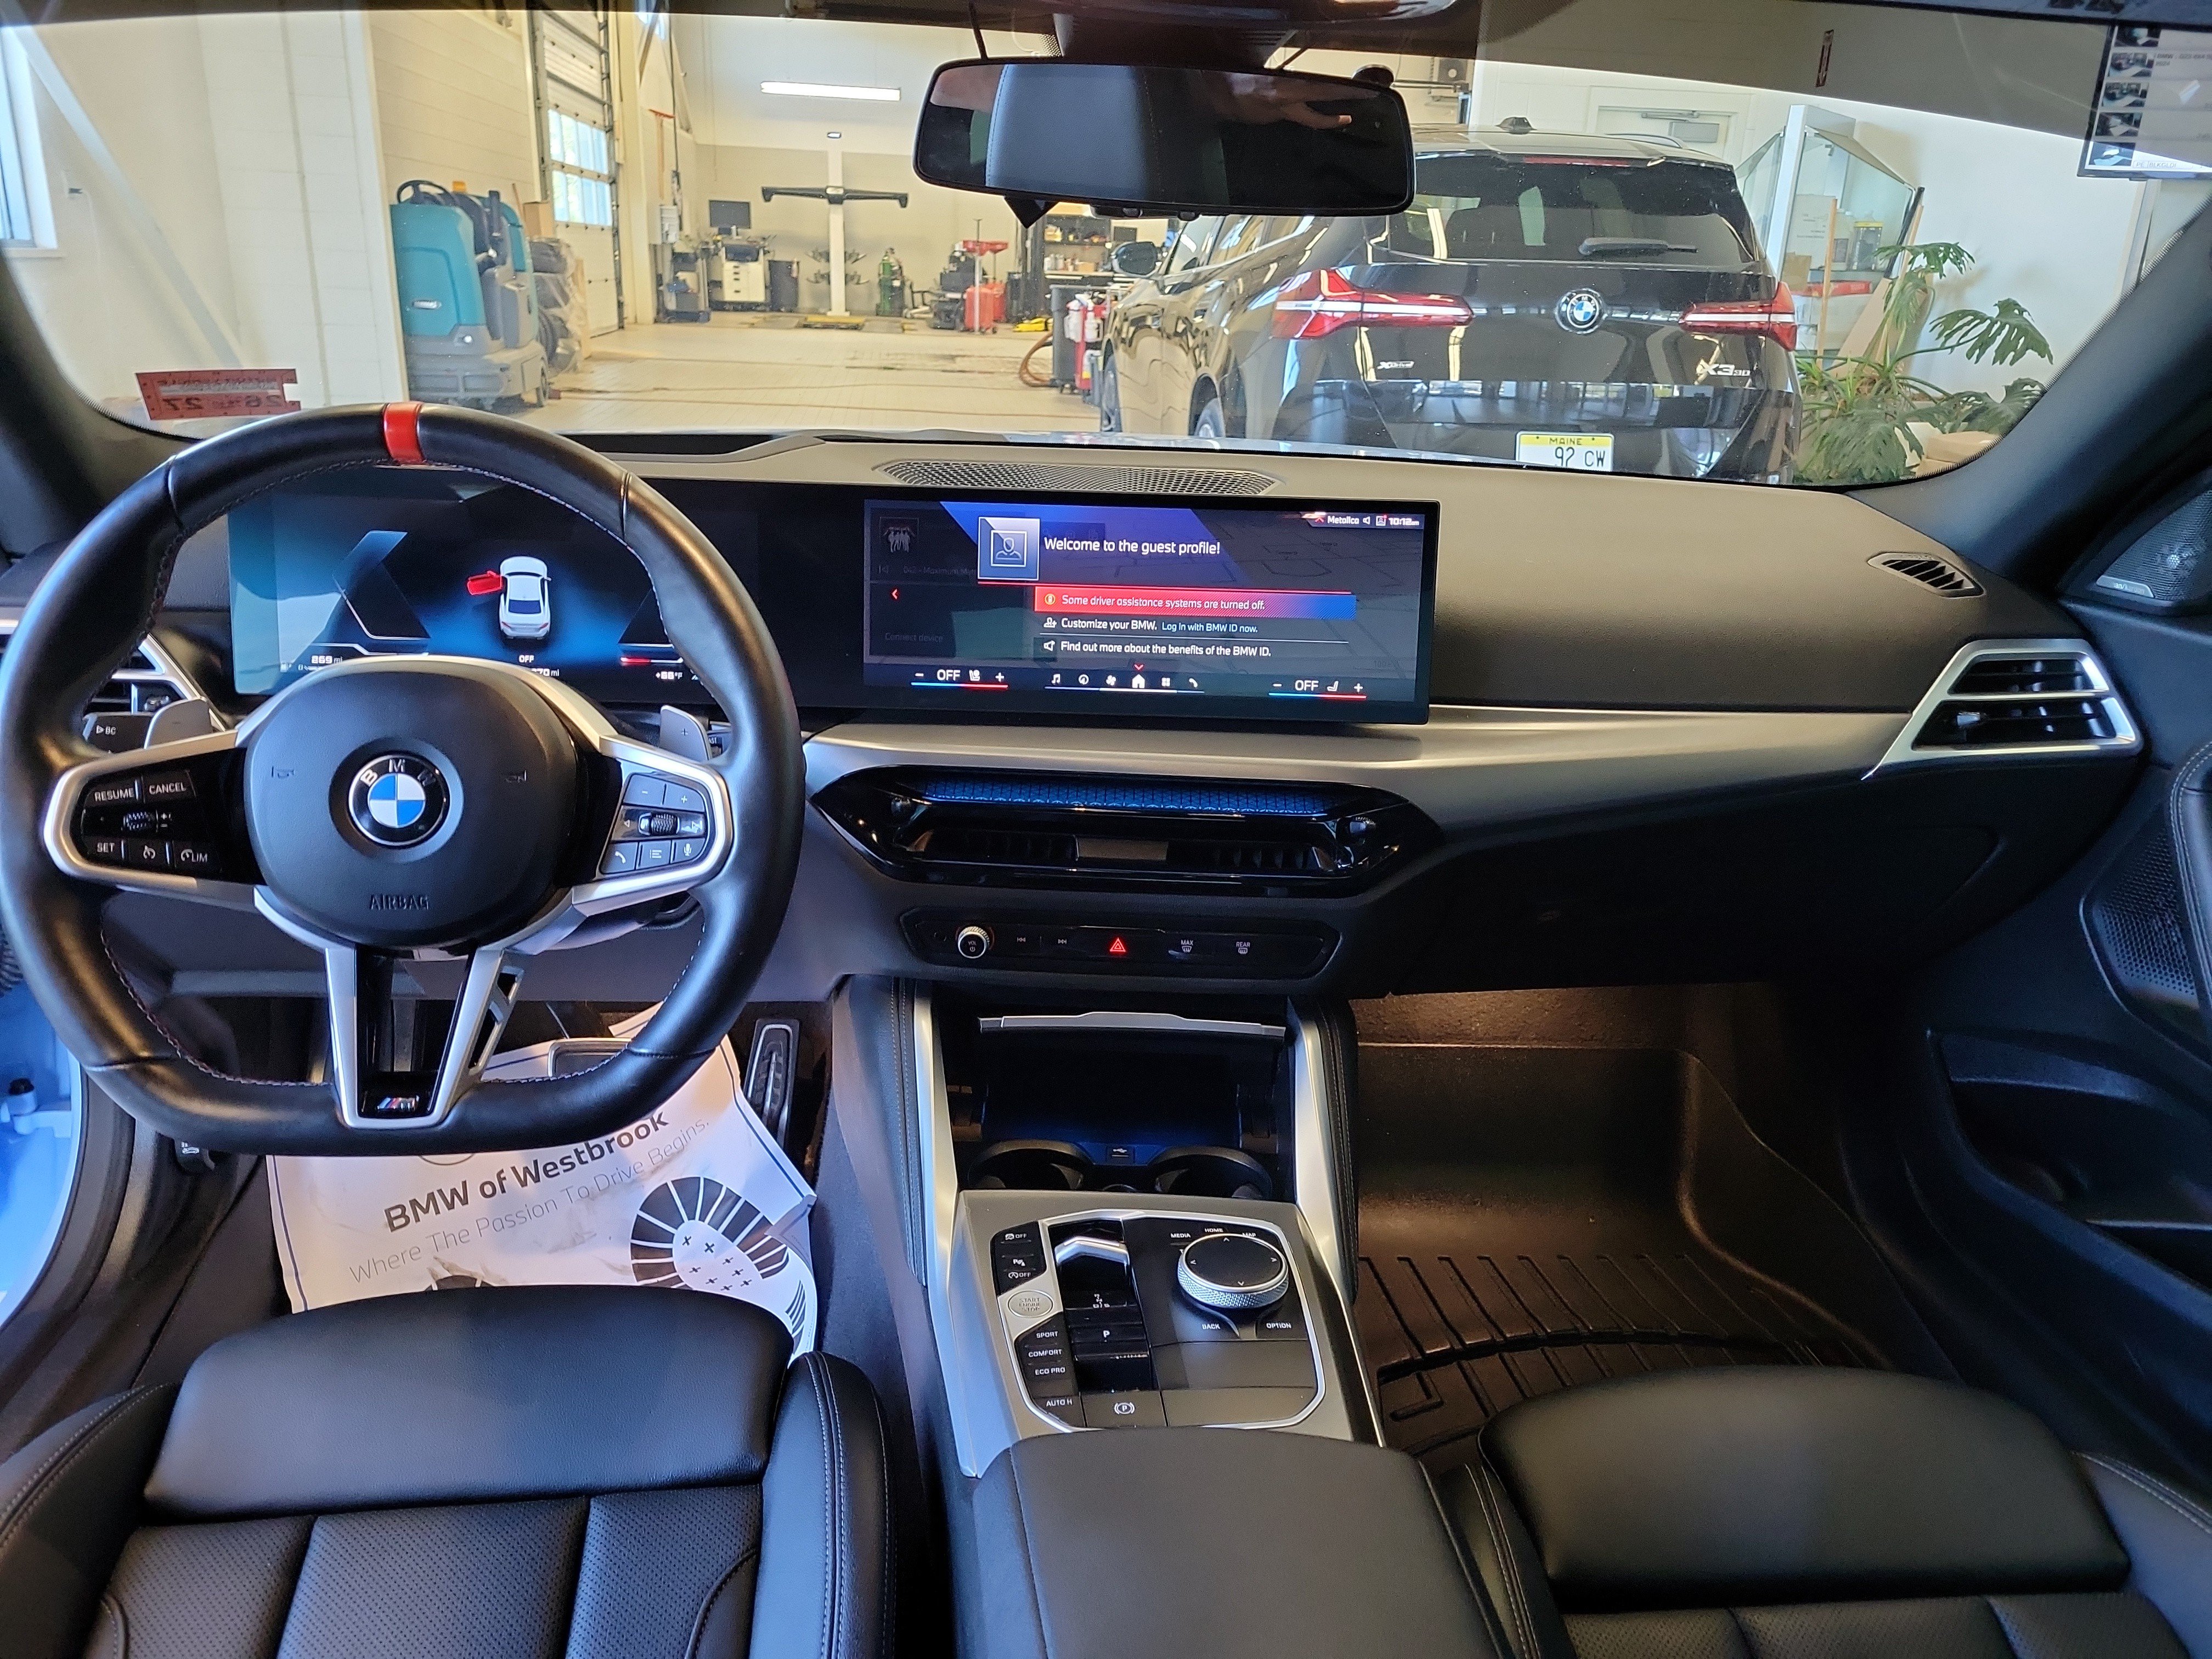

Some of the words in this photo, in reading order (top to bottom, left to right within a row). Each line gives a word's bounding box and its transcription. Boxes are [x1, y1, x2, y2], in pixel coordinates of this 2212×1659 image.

[1549, 437, 1582, 445] MAINE
[1584, 450, 1605, 467] CW
[1043, 537, 1100, 551] Welcome
[1103, 540, 1115, 552] to
[1119, 539, 1138, 552] the
[1141, 541, 1176, 555] guest
[1178, 541, 1220, 555] profile!
[1062, 595, 1088, 605] Some
[1090, 596, 1117, 606] driver
[1116, 597, 1163, 607] assistance
[1165, 599, 1202, 609] systems
[1204, 600, 1218, 608] are
[1220, 600, 1249, 610] turned
[1251, 600, 1265, 610] off.
[1061, 618, 1108, 628] Customize
[1109, 621, 1130, 630] your
[1131, 620, 1157, 630] BMW.
[1162, 622, 1177, 632] Log
[1179, 623, 1186, 631] in
[1187, 623, 1204, 631] with
[1206, 623, 1227, 632] BMW
[1229, 624, 1238, 632] ID
[1060, 641, 1081, 651] Find
[1082, 643, 1098, 652] out
[1124, 643, 1150, 653] about
[1152, 644, 1166, 653] the
[1169, 644, 1204, 655] benefits
[1205, 645, 1215, 654] of
[1216, 646, 1231, 656] the
[1233, 646, 1257, 656] BMW
[1259, 647, 1272, 657] ID.
[936, 669, 961, 681] OFF
[1295, 680, 1319, 691] OFF
[360, 759, 437, 787] BMW
[94, 788, 134, 802] RESUME
[149, 782, 187, 795] CANCEL
[97, 842, 115, 853] SET
[191, 852, 208, 863] LIM
[369, 894, 431, 912] AIRBAG
[384, 1180, 469, 1232] BMW
[479, 1168, 507, 1199] of
[510, 1111, 669, 1188] Westbrook
[349, 1245, 421, 1284] Where
[425, 1228, 470, 1252] The
[475, 1199, 558, 1238] Passion
[560, 1185, 590, 1204] To
[594, 1160, 644, 1192] Drive
[648, 1118, 709, 1166] Begins.
[1028, 1349, 1062, 1358] COMFORT
[1046, 1399, 1065, 1407] AUTO
